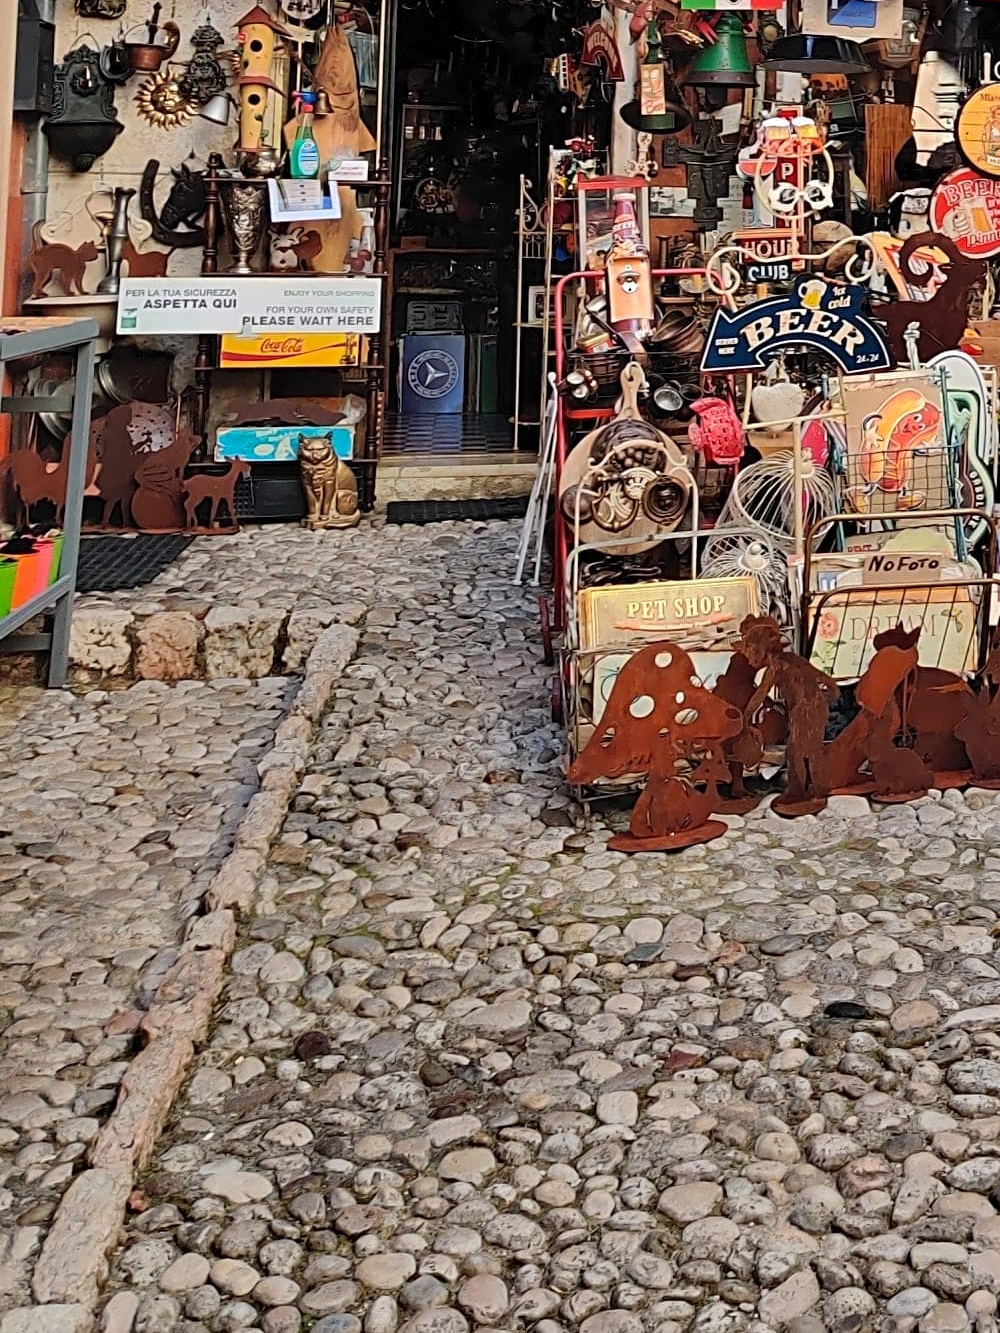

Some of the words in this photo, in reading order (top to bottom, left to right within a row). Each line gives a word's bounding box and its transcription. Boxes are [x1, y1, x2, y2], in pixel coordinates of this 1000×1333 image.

[125, 289, 145, 297] PER
[147, 289, 160, 297] LA
[161, 289, 182, 297] TUA
[183, 289, 237, 297] SICUREZZA
[143, 299, 208, 309] ASPETTA
[212, 299, 237, 309] QUI
[266, 306, 286, 314] FOR
[287, 306, 314, 314] YOUR
[315, 306, 338, 314] OWN
[340, 306, 374, 314] SAFETY
[242, 316, 295, 326] PLEASE
[301, 316, 333, 326] WAIT
[337, 316, 374, 326] HERE
[739, 308, 865, 357] BEER
[626, 598, 667, 620] PET
[672, 595, 726, 618] SHOP
